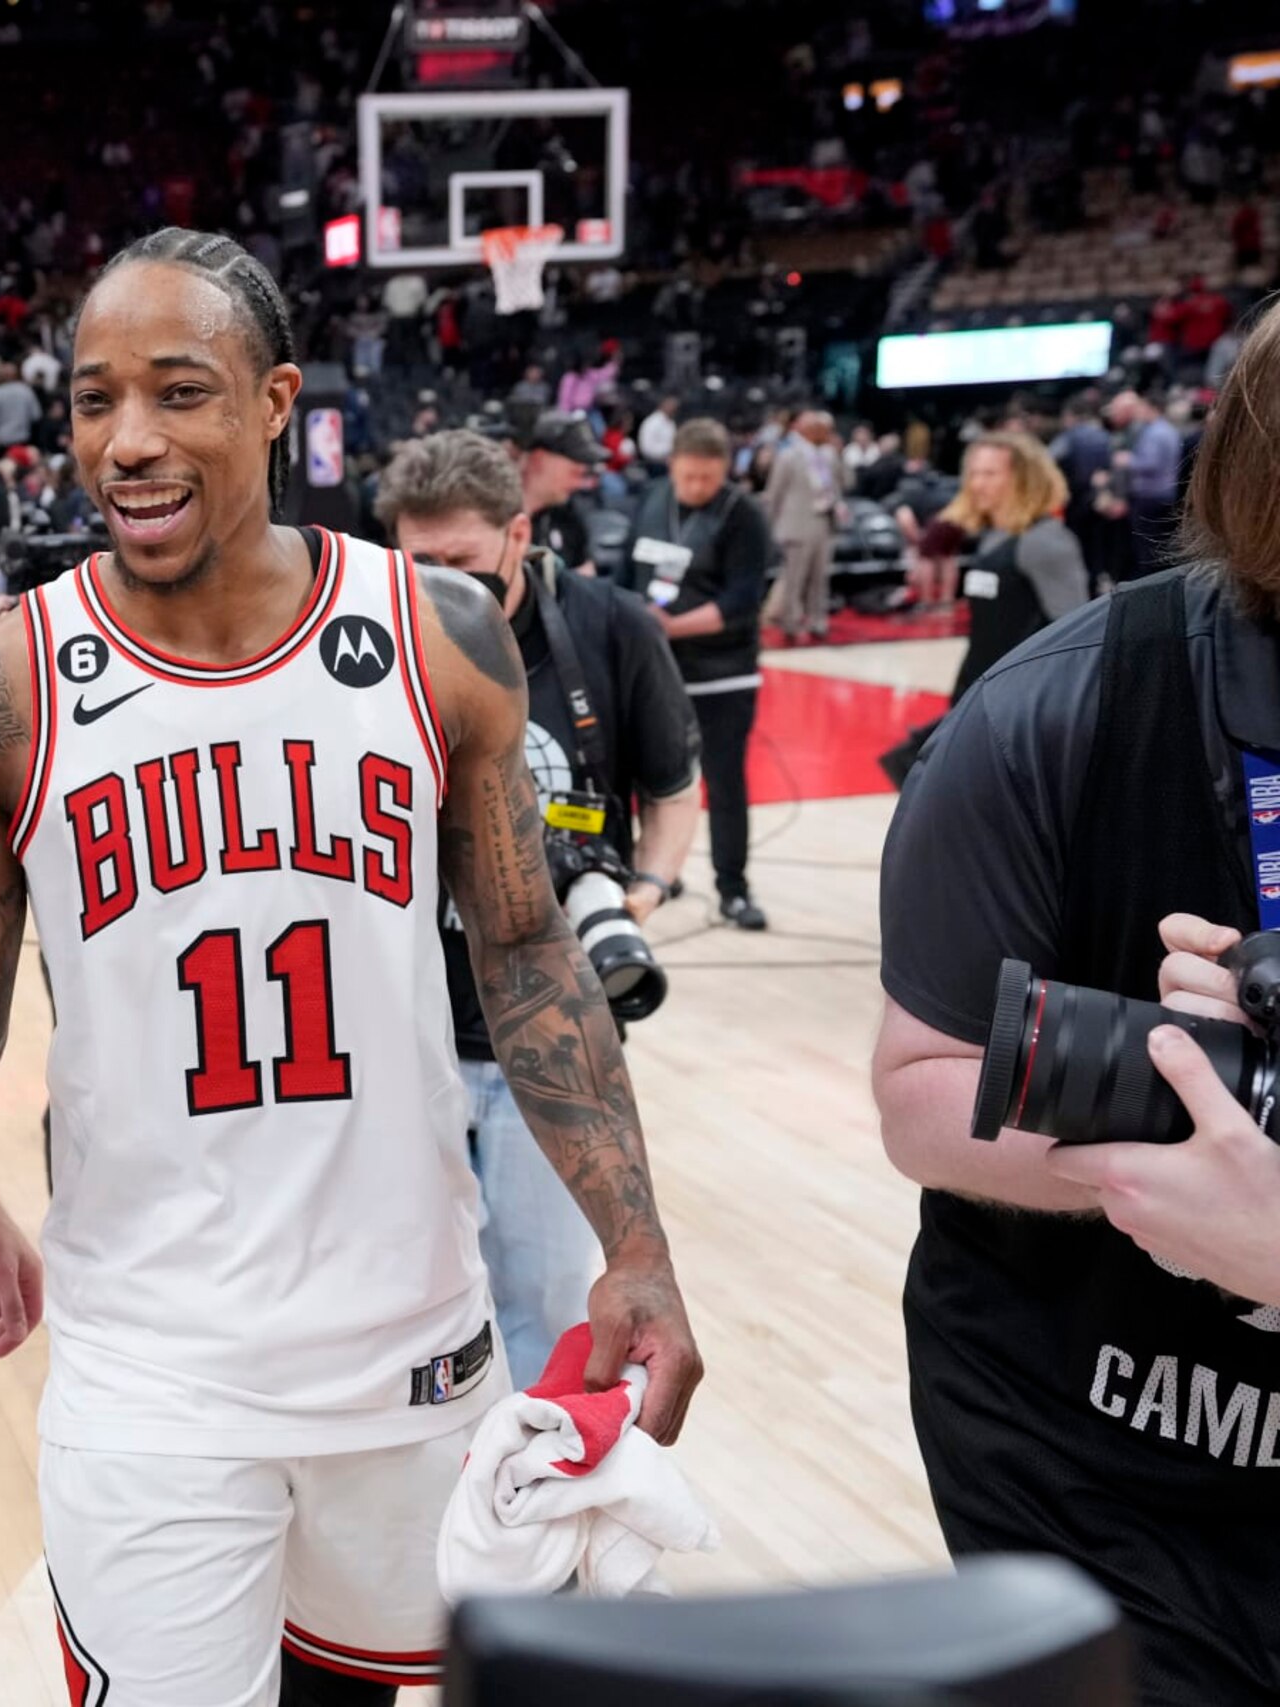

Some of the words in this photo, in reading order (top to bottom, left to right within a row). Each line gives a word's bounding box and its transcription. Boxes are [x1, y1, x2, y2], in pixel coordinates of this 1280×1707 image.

[70, 640, 97, 678] 6
[63, 739, 413, 942] BULLS
[1249, 773, 1280, 811] NBA
[176, 918, 353, 1117] 11
